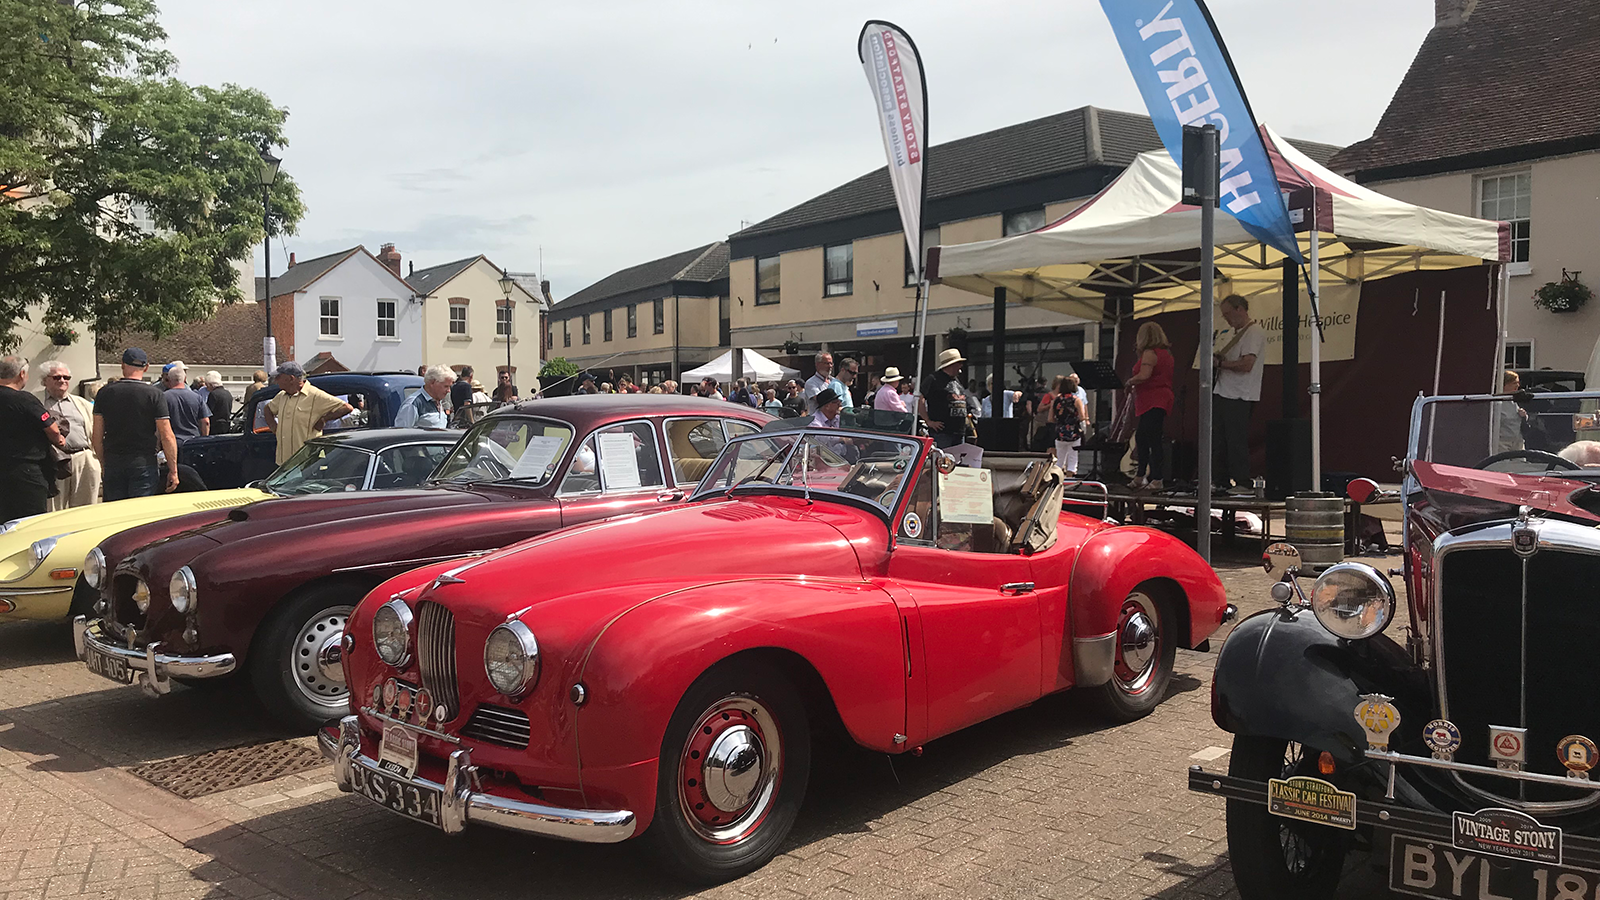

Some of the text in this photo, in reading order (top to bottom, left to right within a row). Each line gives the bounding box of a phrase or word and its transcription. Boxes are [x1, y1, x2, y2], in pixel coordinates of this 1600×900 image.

[1289, 780, 1305, 789] STONY
[1271, 782, 1352, 812] CLASSIC CAR FESTIVAL
[1294, 808, 1310, 817] JUNE
[1311, 811, 1328, 820] 2014
[1457, 816, 1556, 849] VINTAGE STONY
[1478, 842, 1535, 857] NEW YEARS DAY 2019
[1403, 843, 1600, 900] BYL 18
